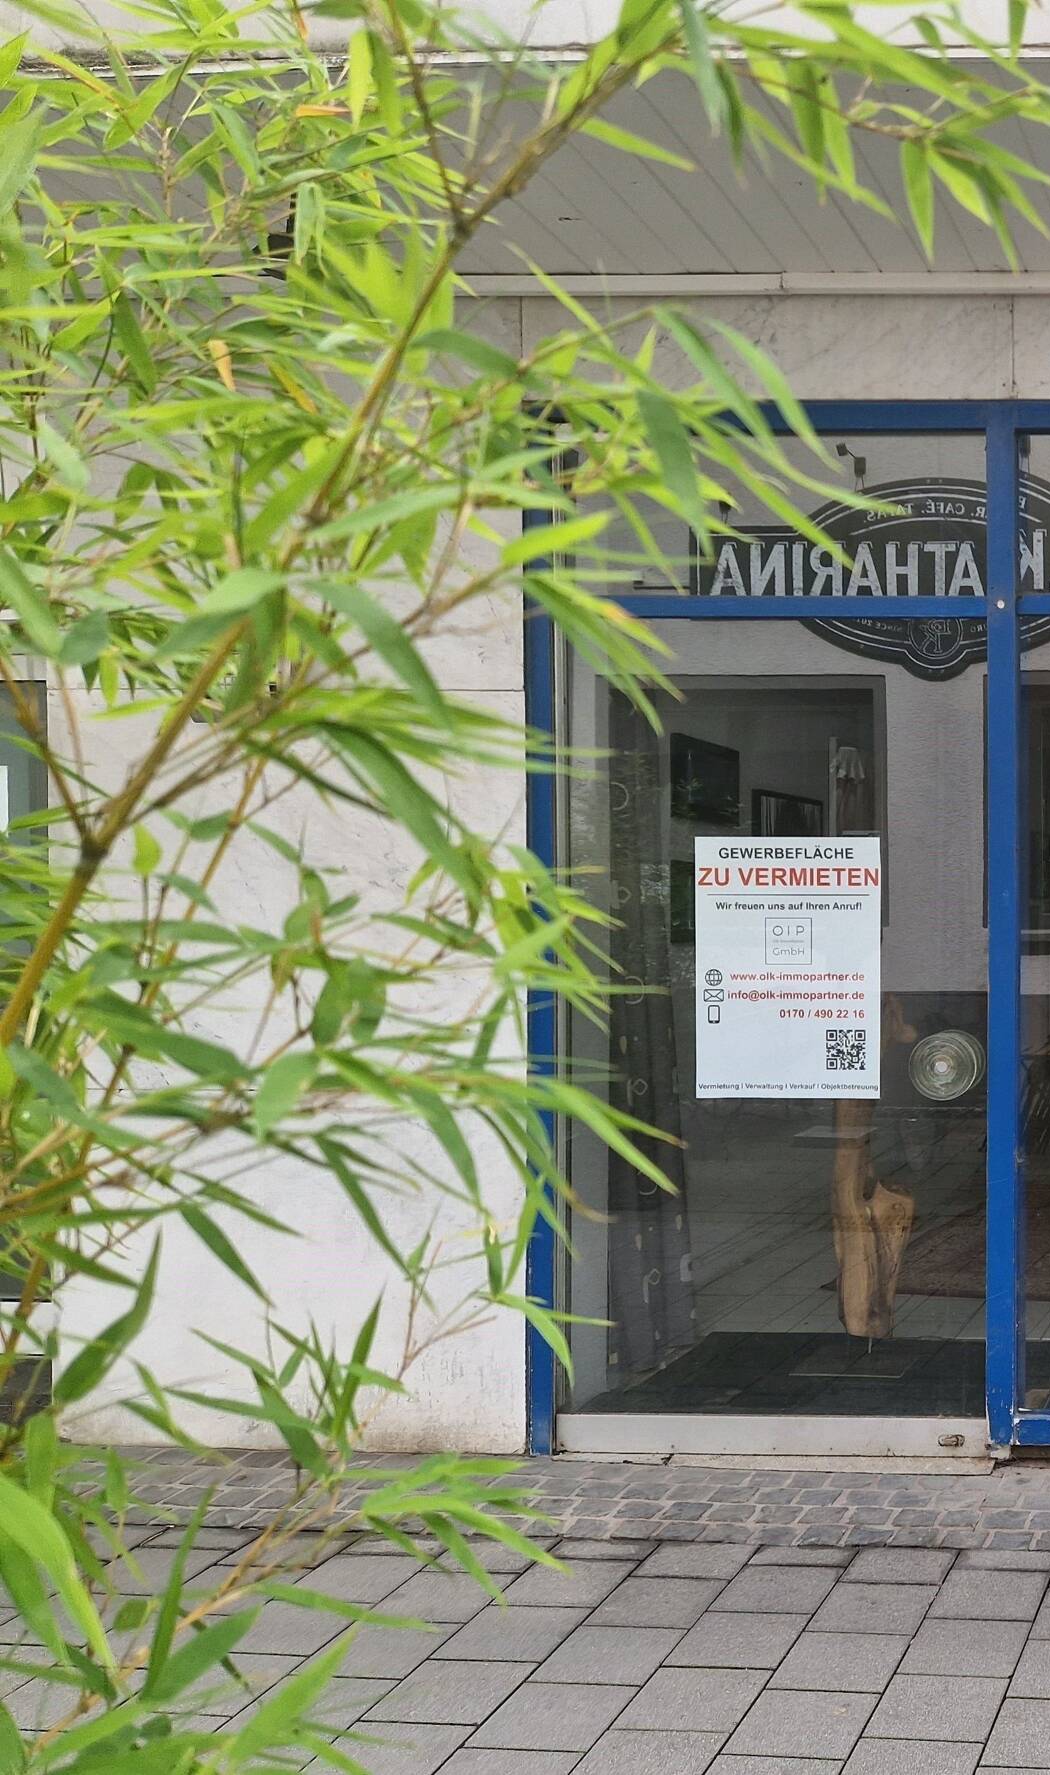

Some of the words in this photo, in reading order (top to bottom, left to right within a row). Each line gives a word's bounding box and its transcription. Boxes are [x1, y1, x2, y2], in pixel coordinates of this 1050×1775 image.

[718, 845, 854, 860] GEWERBEFLÄCHE
[698, 868, 730, 887] ZU
[738, 868, 880, 887] VERMIETEN
[715, 902, 733, 910] Wir
[735, 902, 765, 910] freuen
[788, 902, 803, 910] auf
[806, 902, 830, 910] Ihren
[833, 902, 862, 910] Anruf!
[772, 947, 805, 956] GmbH
[730, 973, 865, 982] www.olk-immopartner.de
[727, 990, 865, 1002] info@olk-immopartner.de
[779, 1010, 805, 1019] 0170
[814, 1010, 833, 1019] 490
[836, 1010, 849, 1019] 22
[853, 1010, 865, 1019] 16
[699, 1083, 740, 1091] Vermietung
[745, 1083, 784, 1091] Verwaltung
[821, 1083, 879, 1092] Objektbetreuung
